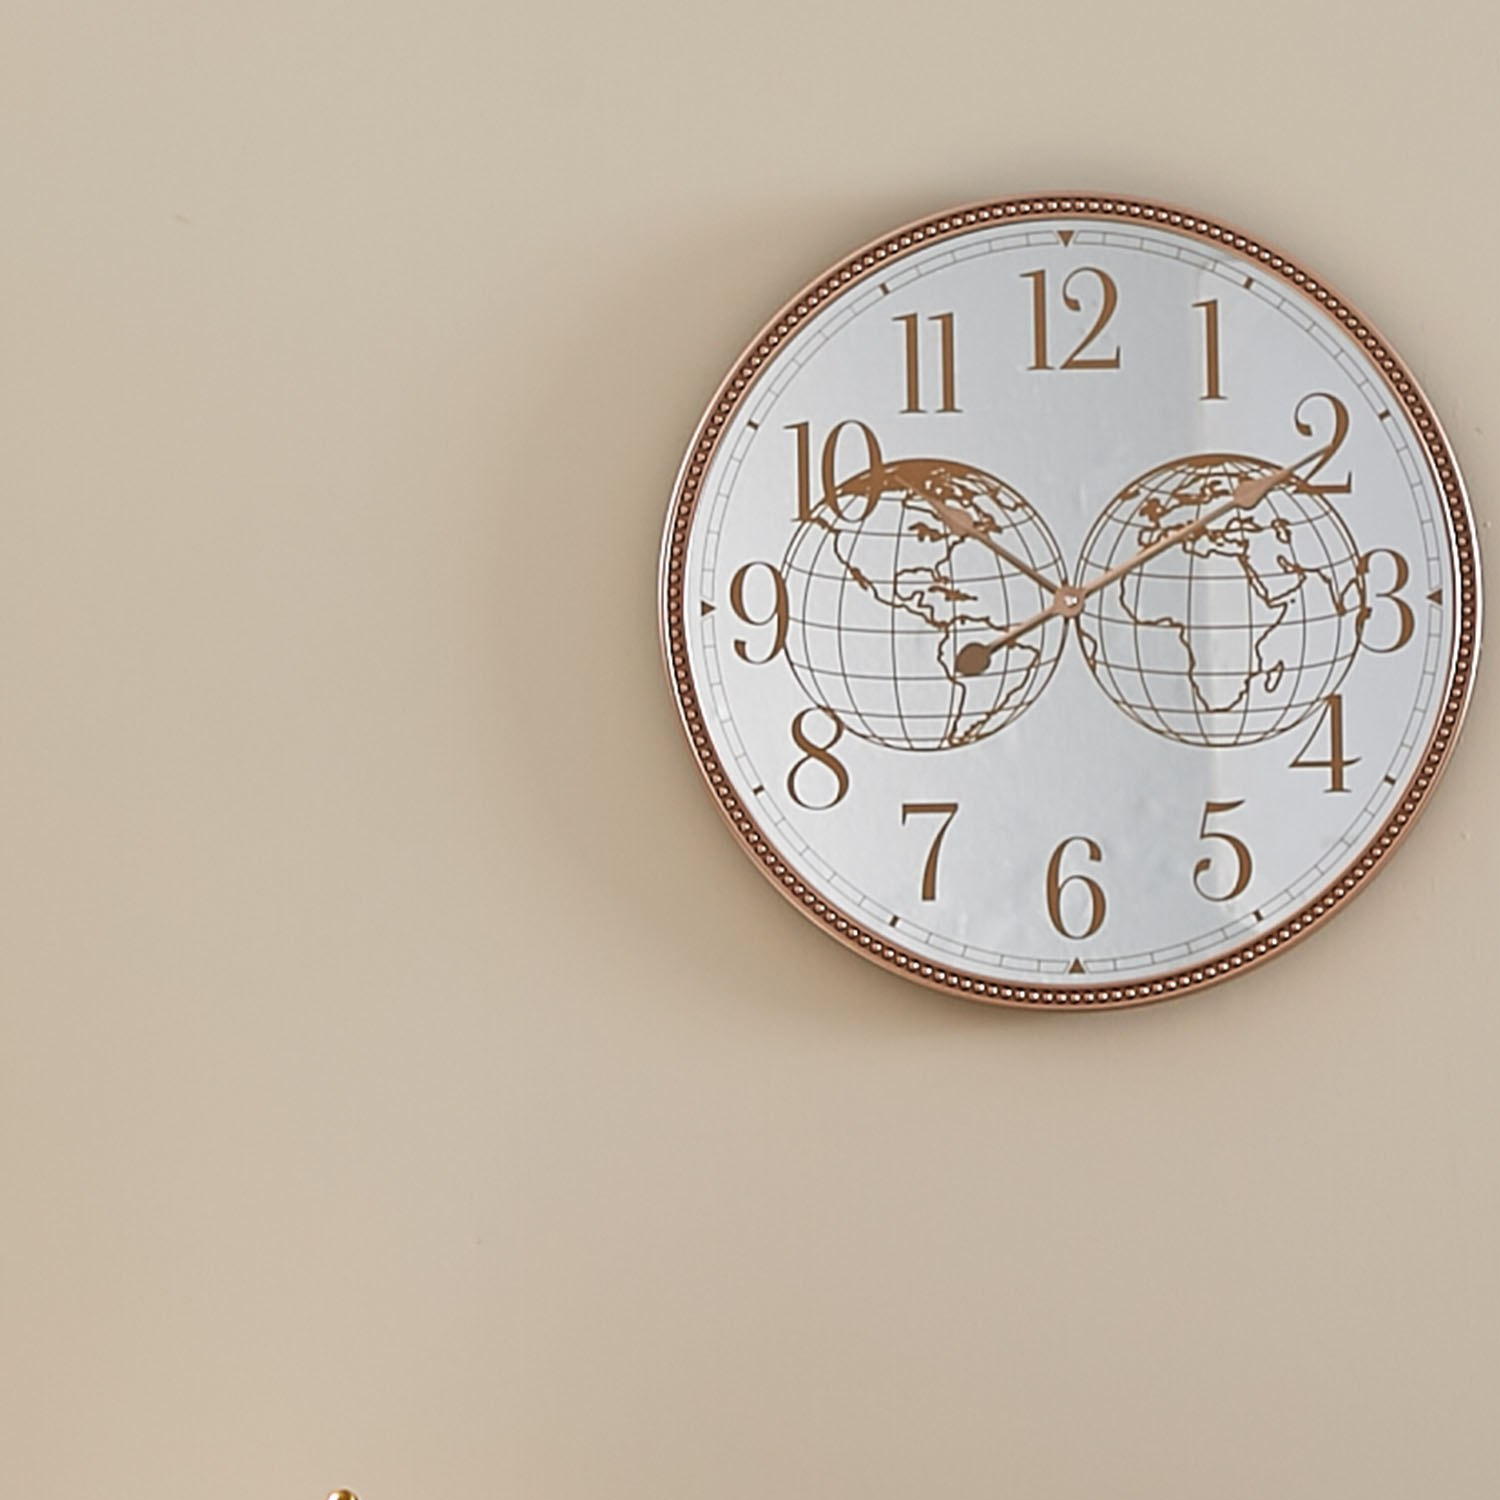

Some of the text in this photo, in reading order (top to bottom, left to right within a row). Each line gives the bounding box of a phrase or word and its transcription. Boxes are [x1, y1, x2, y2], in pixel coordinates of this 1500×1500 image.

[892, 312, 962, 414] 11
[1019, 266, 1121, 371] 12
[1191, 299, 1226, 401] 1
[784, 420, 883, 523] 10
[1293, 393, 1353, 495] 2
[729, 562, 788, 665] 9
[1359, 548, 1415, 653] 3
[786, 707, 850, 810] 8
[1288, 693, 1361, 794] 4
[901, 802, 959, 902] 7
[1045, 836, 1107, 940] 6
[1193, 800, 1253, 902] 5
